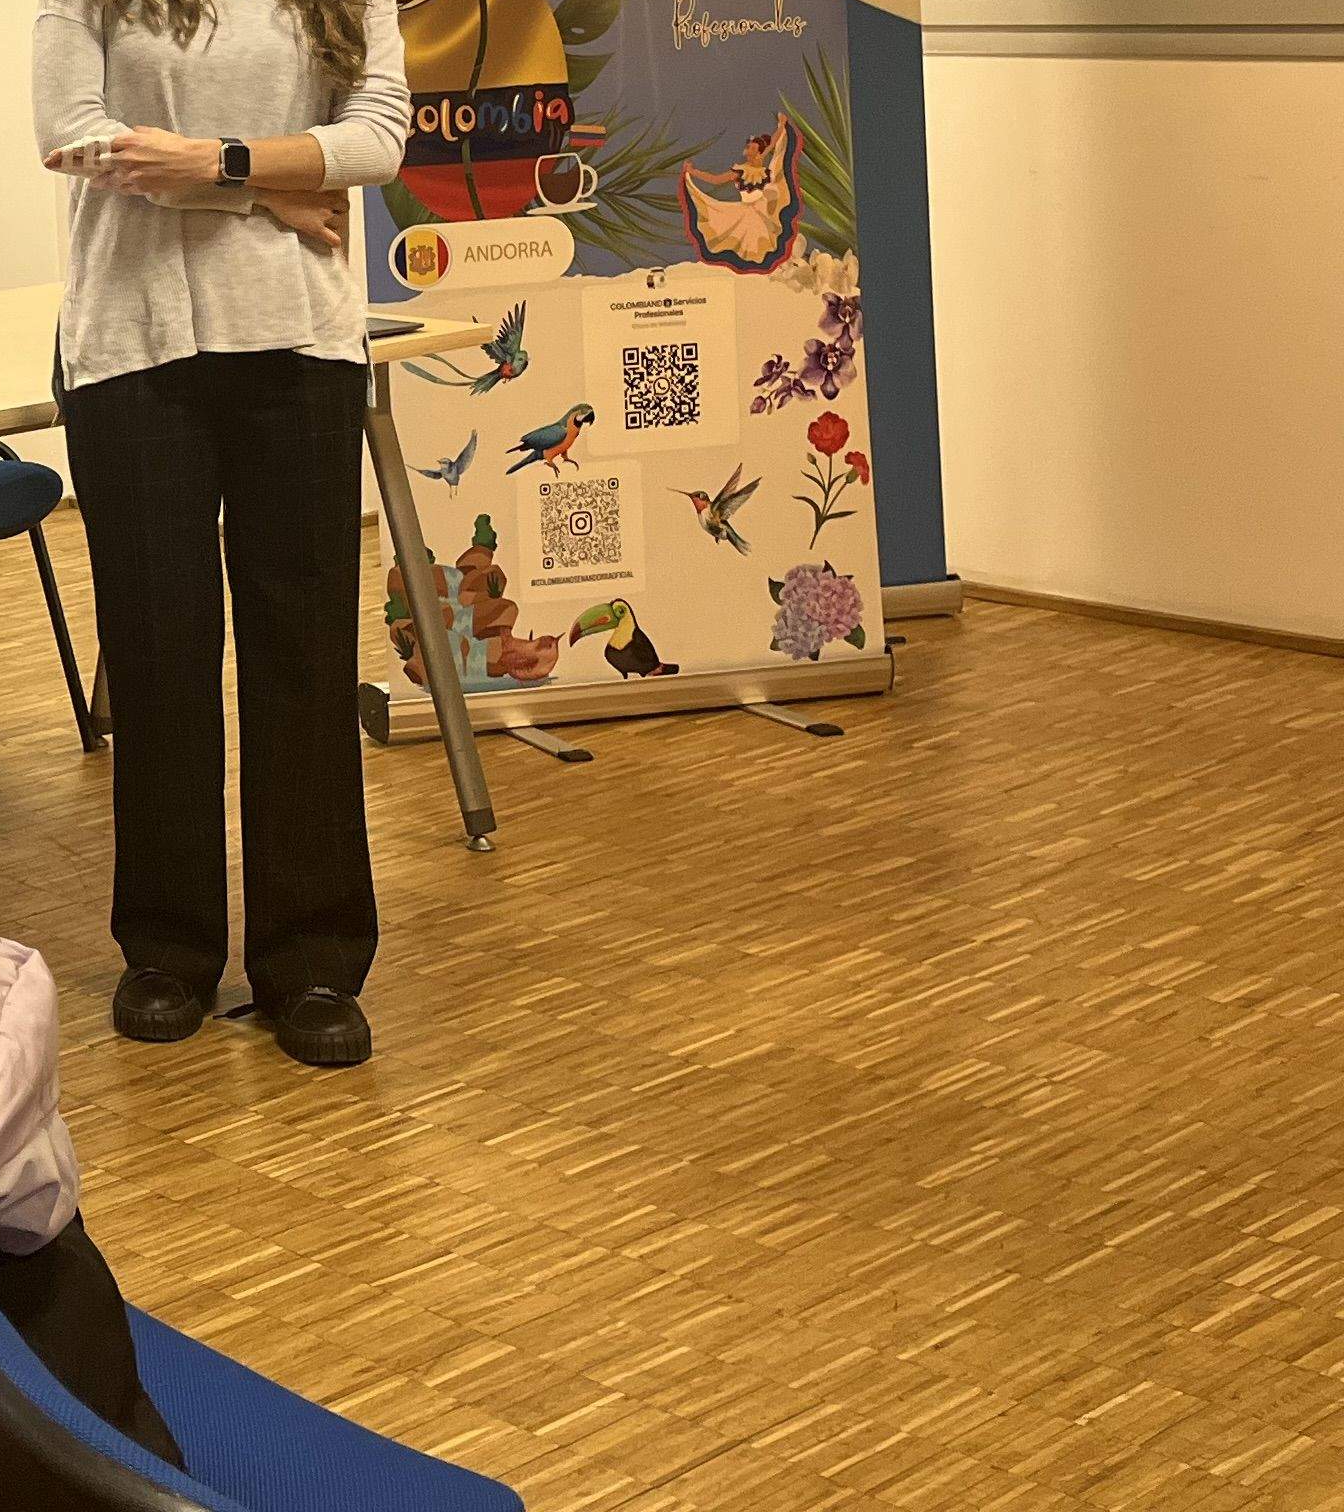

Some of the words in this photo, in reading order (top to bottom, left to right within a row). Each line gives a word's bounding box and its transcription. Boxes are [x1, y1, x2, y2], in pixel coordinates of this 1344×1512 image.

[464, 240, 553, 263] ANDORRA
[673, 296, 707, 306] Servicios
[634, 309, 684, 319] Profesionales
